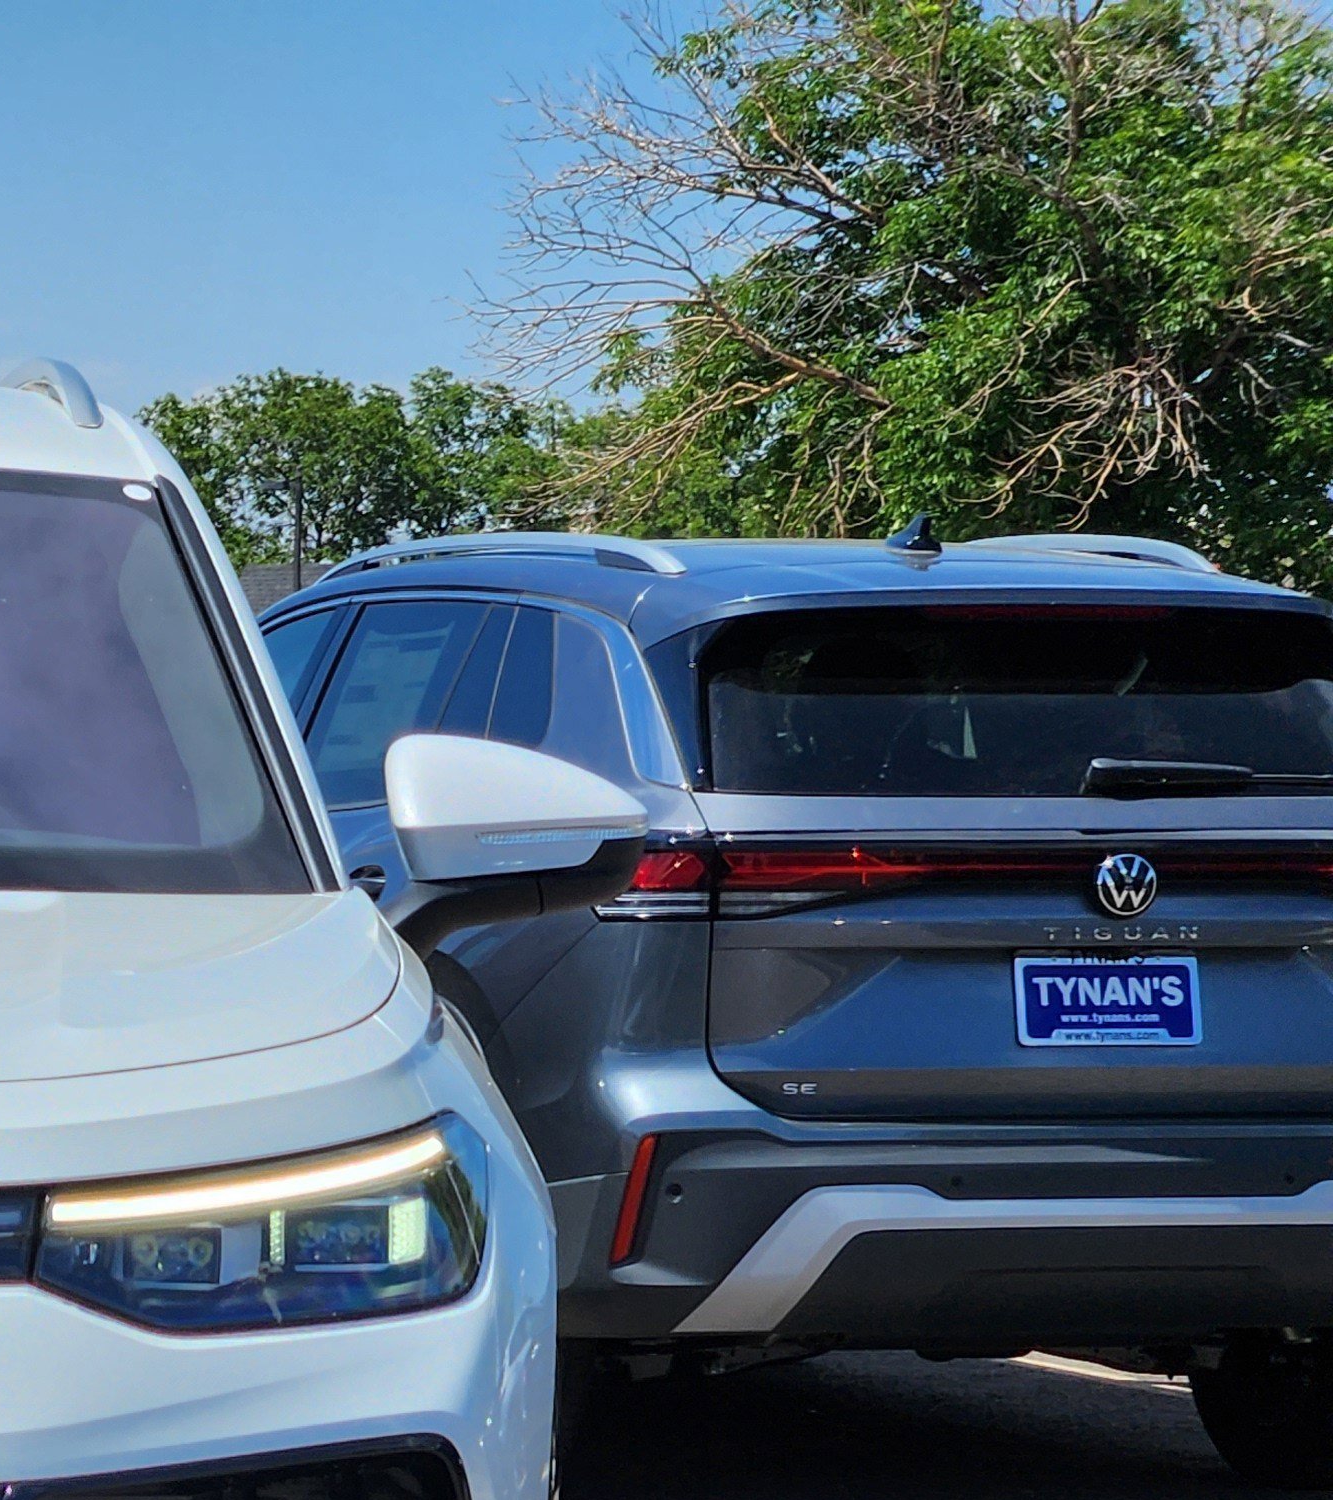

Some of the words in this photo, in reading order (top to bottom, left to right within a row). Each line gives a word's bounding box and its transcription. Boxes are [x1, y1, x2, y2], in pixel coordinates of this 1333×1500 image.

[1043, 926, 1200, 941] TIGUAN
[1032, 976, 1184, 1007] TYNAN'S
[1060, 1012, 1160, 1025] www.tynans.com
[1064, 1031, 1160, 1042] www.tynans.com
[782, 1082, 817, 1095] SE
